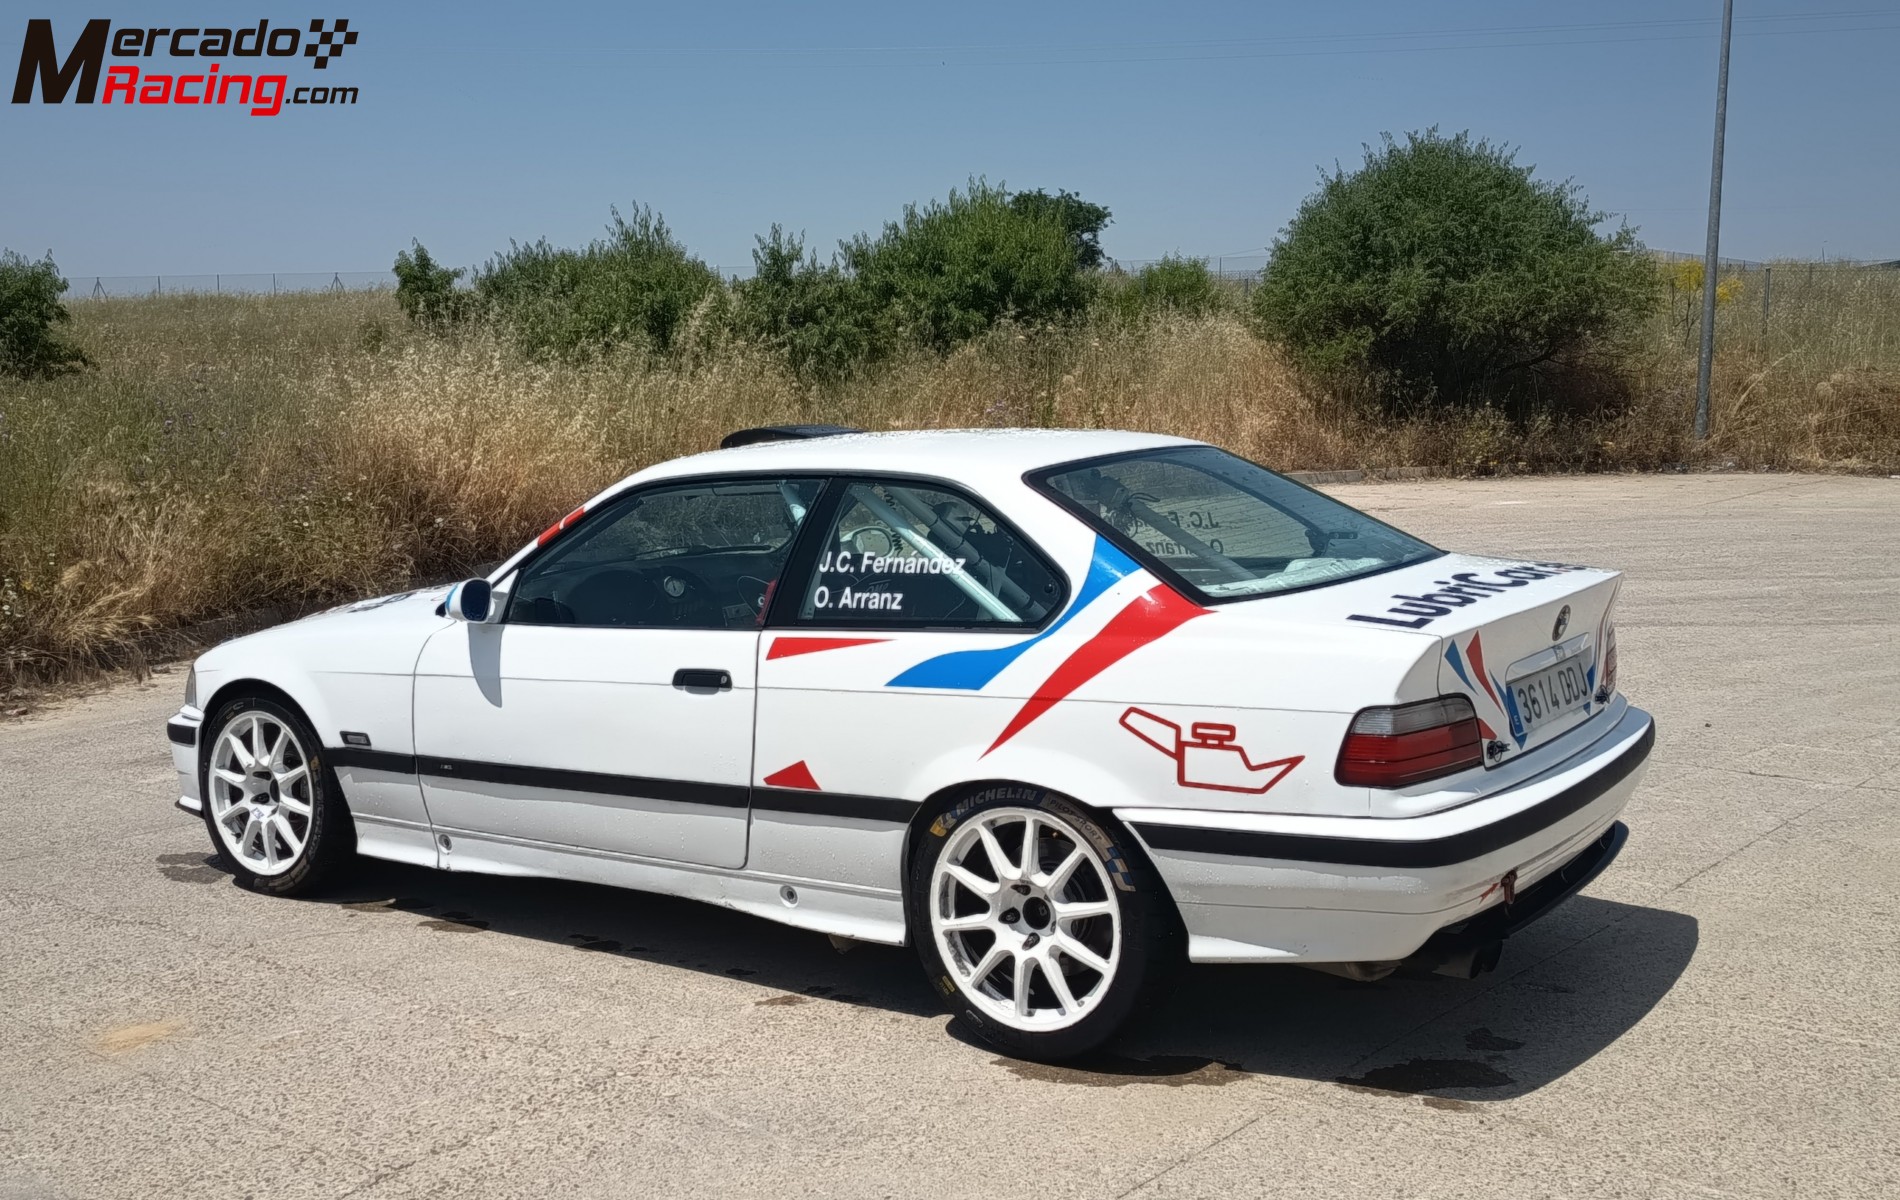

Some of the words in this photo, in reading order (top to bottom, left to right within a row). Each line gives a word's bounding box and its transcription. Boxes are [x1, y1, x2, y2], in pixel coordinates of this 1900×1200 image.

[818, 551, 854, 573] J.C.
[861, 550, 967, 575] Fernández
[813, 586, 834, 609] O.
[839, 586, 904, 610] Arranz
[1517, 675, 1560, 724] 3614
[1558, 662, 1588, 706] DDJ
[955, 787, 1037, 816] MICHELIN
[1050, 799, 1076, 816] PILOT
